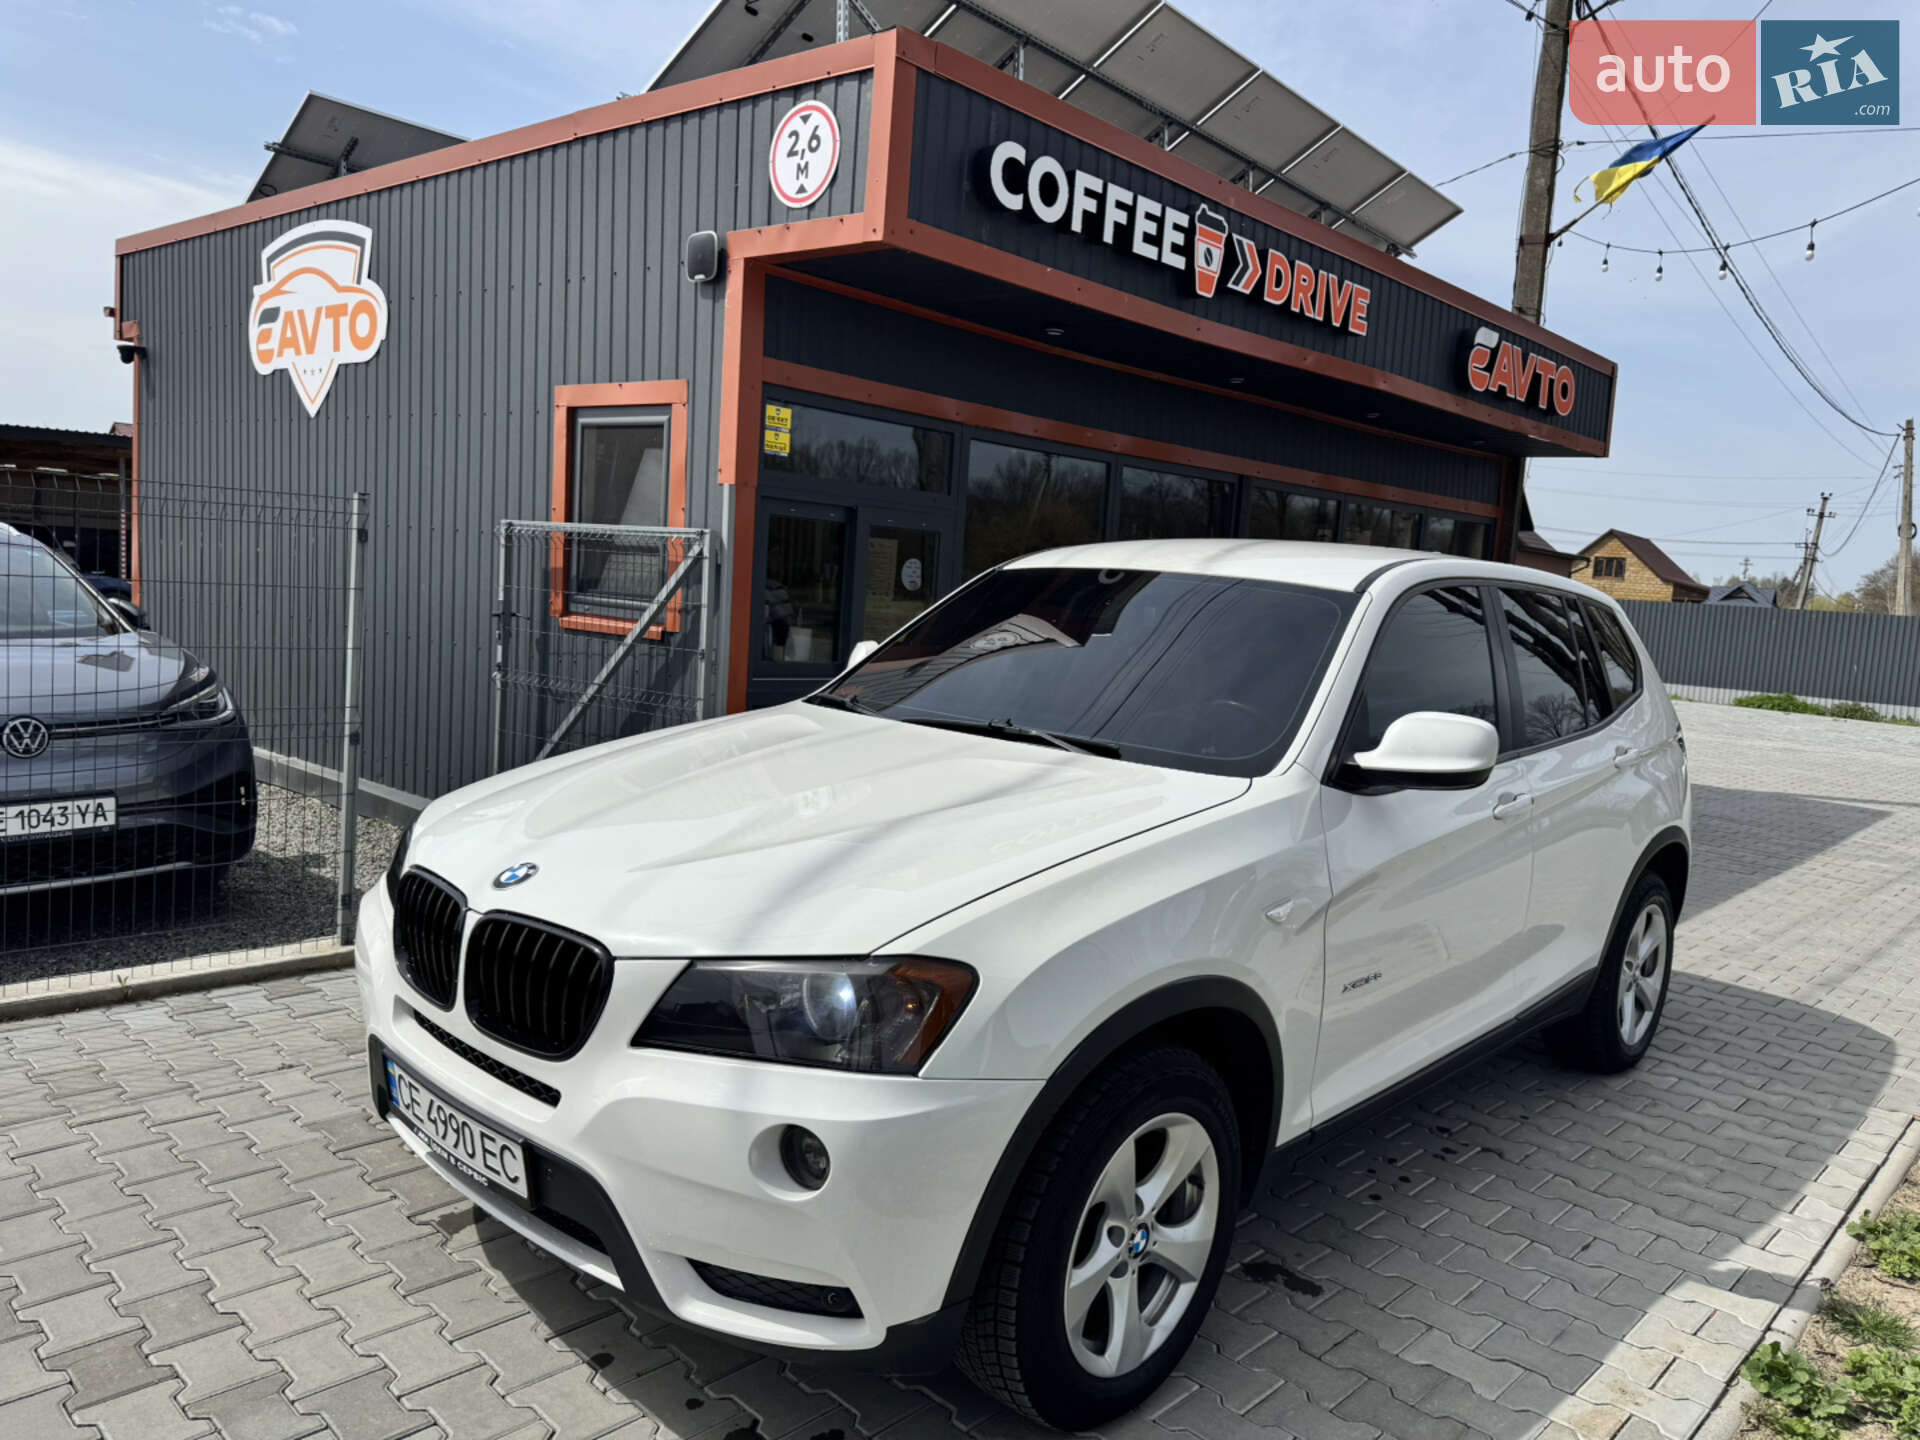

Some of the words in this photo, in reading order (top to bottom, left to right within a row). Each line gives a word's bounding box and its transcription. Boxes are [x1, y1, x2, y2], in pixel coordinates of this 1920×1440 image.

[786, 125, 821, 161] 2,6
[990, 140, 1190, 271] COFFEE
[1263, 248, 1371, 337] DRIVE
[15, 805, 69, 830] 1043
[76, 802, 108, 824] YA
[397, 1073, 424, 1124] CE
[427, 1098, 476, 1159] 4990
[479, 1130, 520, 1184] EC
